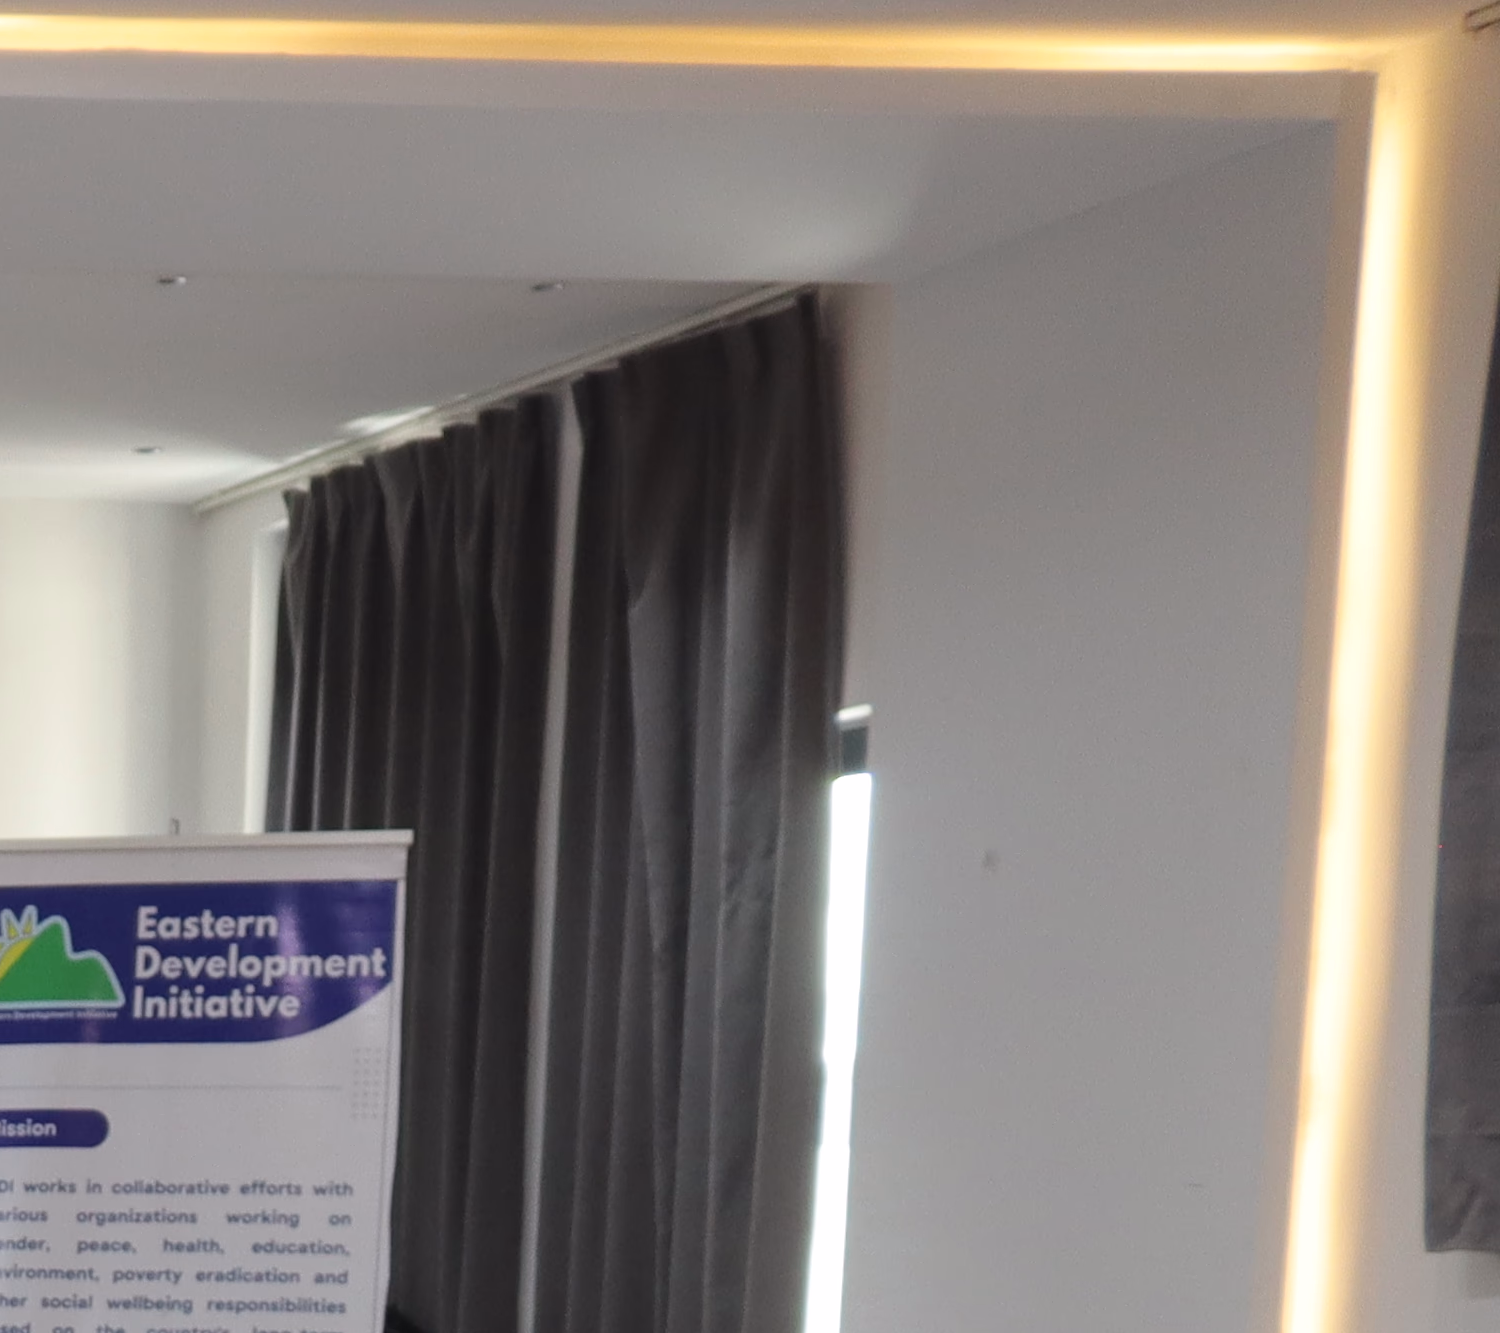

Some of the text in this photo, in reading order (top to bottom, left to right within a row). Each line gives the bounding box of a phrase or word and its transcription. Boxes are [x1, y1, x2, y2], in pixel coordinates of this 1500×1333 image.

[137, 906, 279, 940] Eastern
[135, 943, 387, 988] Development
[133, 984, 300, 1019] Initiative
[23, 1178, 77, 1194] works
[86, 1177, 103, 1194] in
[111, 1179, 231, 1195] collaborative
[239, 1179, 303, 1196] efforts
[313, 1180, 354, 1196] with
[76, 1207, 199, 1227] organizations
[226, 1208, 301, 1230] working
[328, 1213, 352, 1227] on
[76, 1239, 137, 1254] peace,
[163, 1237, 225, 1255] health,
[251, 1238, 350, 1256] education,
[112, 1268, 183, 1286] poverty
[195, 1266, 301, 1284] eradication
[314, 1270, 349, 1286] and
[41, 1292, 94, 1310] social
[107, 1294, 194, 1315] wellbeing
[207, 1296, 347, 1315] responsibilities
